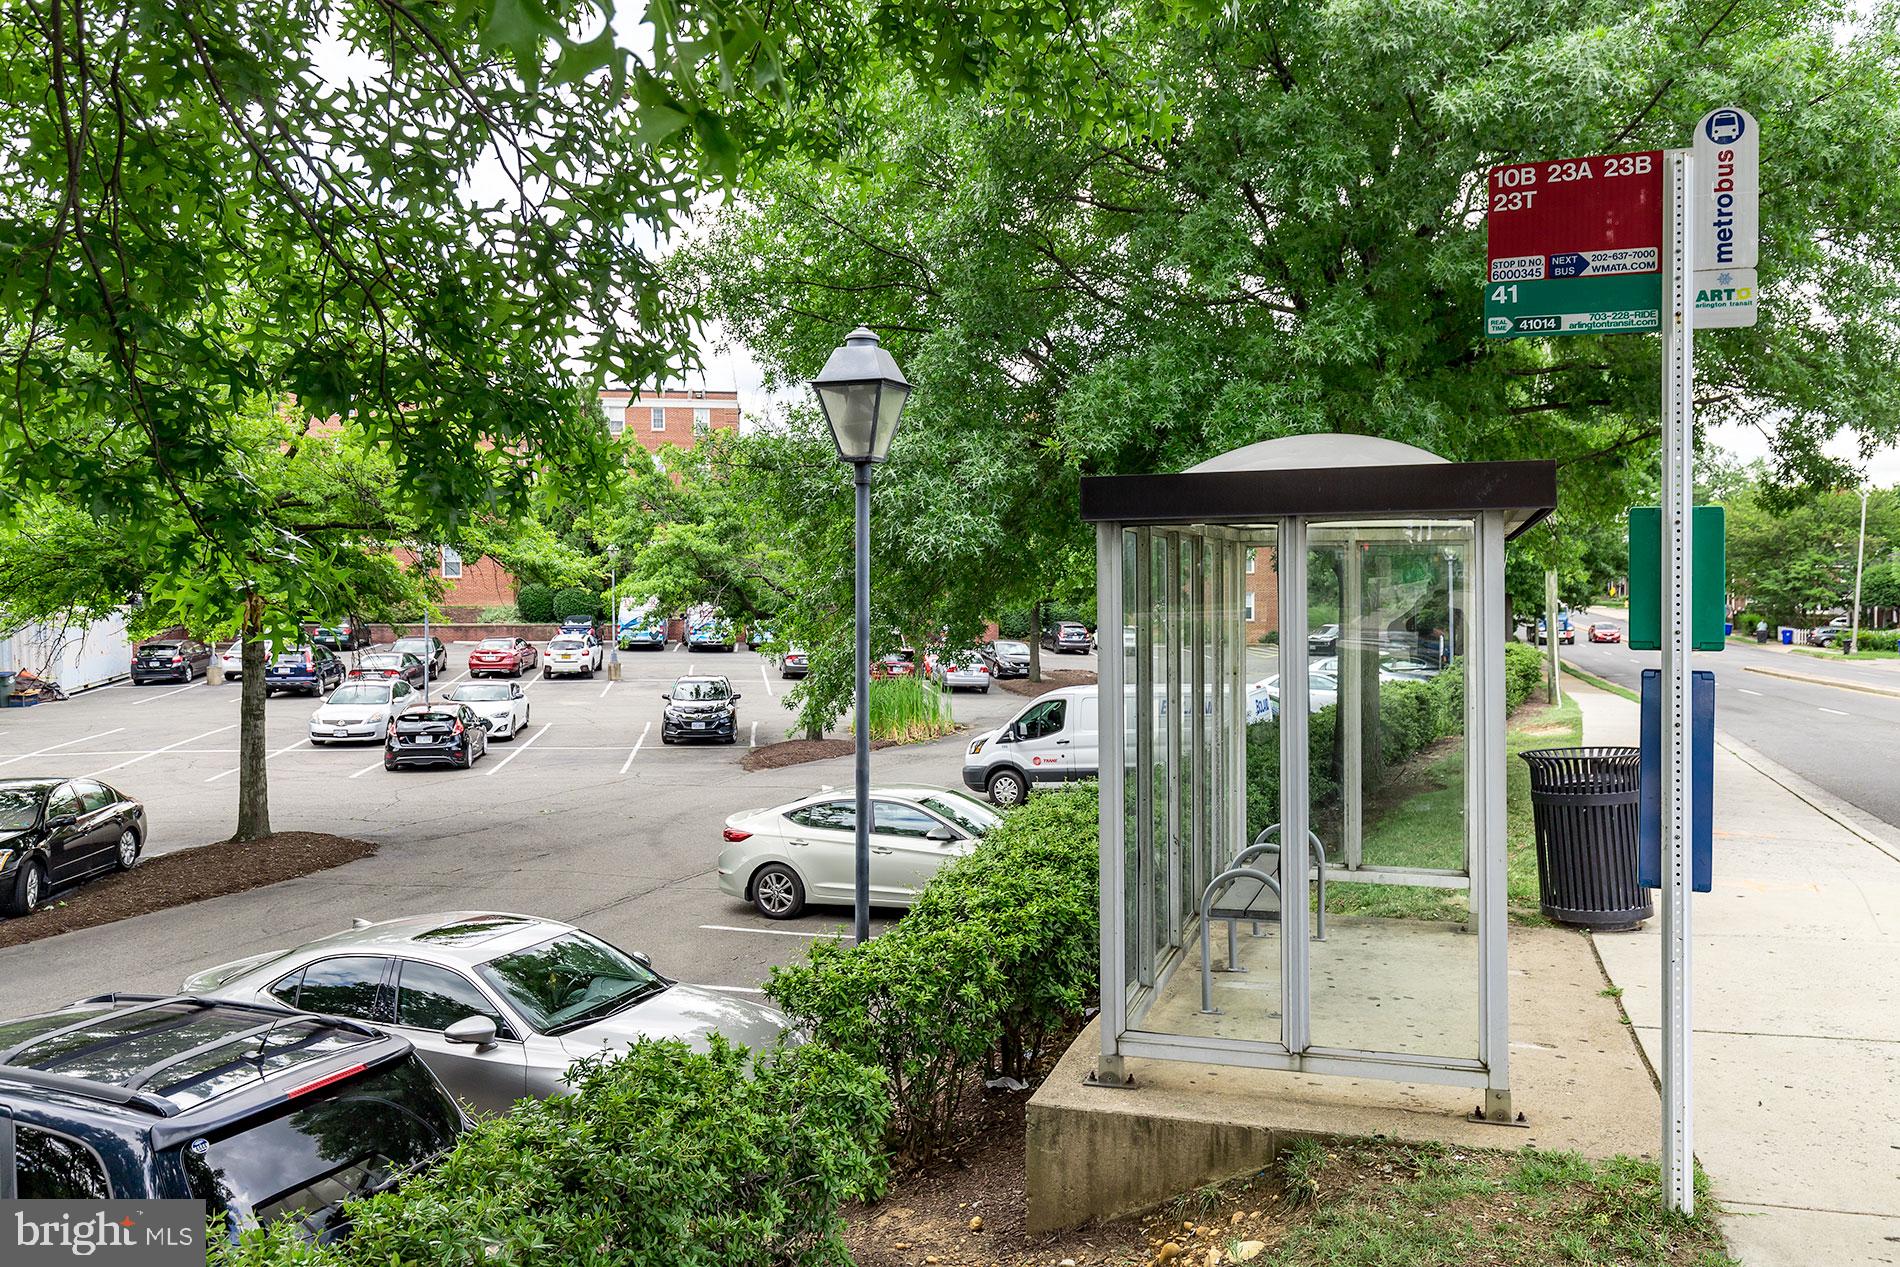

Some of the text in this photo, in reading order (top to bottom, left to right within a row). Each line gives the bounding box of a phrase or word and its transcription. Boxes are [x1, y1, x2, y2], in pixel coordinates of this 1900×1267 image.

[1494, 155, 1652, 188] 10B 23A 23B
[1493, 190, 1538, 212] 23T
[1713, 149, 1734, 263] metrobus
[1551, 255, 1578, 265] NEXT
[1591, 249, 1656, 262] 202-637-7000
[1492, 257, 1544, 270] STOP ID NO.
[1591, 261, 1656, 273] WMATA.COM
[1492, 268, 1542, 280] 6000345
[1554, 266, 1576, 276] BUS
[1491, 284, 1518, 304] 41
[1695, 288, 1736, 302] ART
[1695, 301, 1727, 309] arlington
[1589, 310, 1657, 321] 703-228-RIDE
[1519, 318, 1557, 330] 41014
[1568, 318, 1657, 330] arlingtontransit.com
